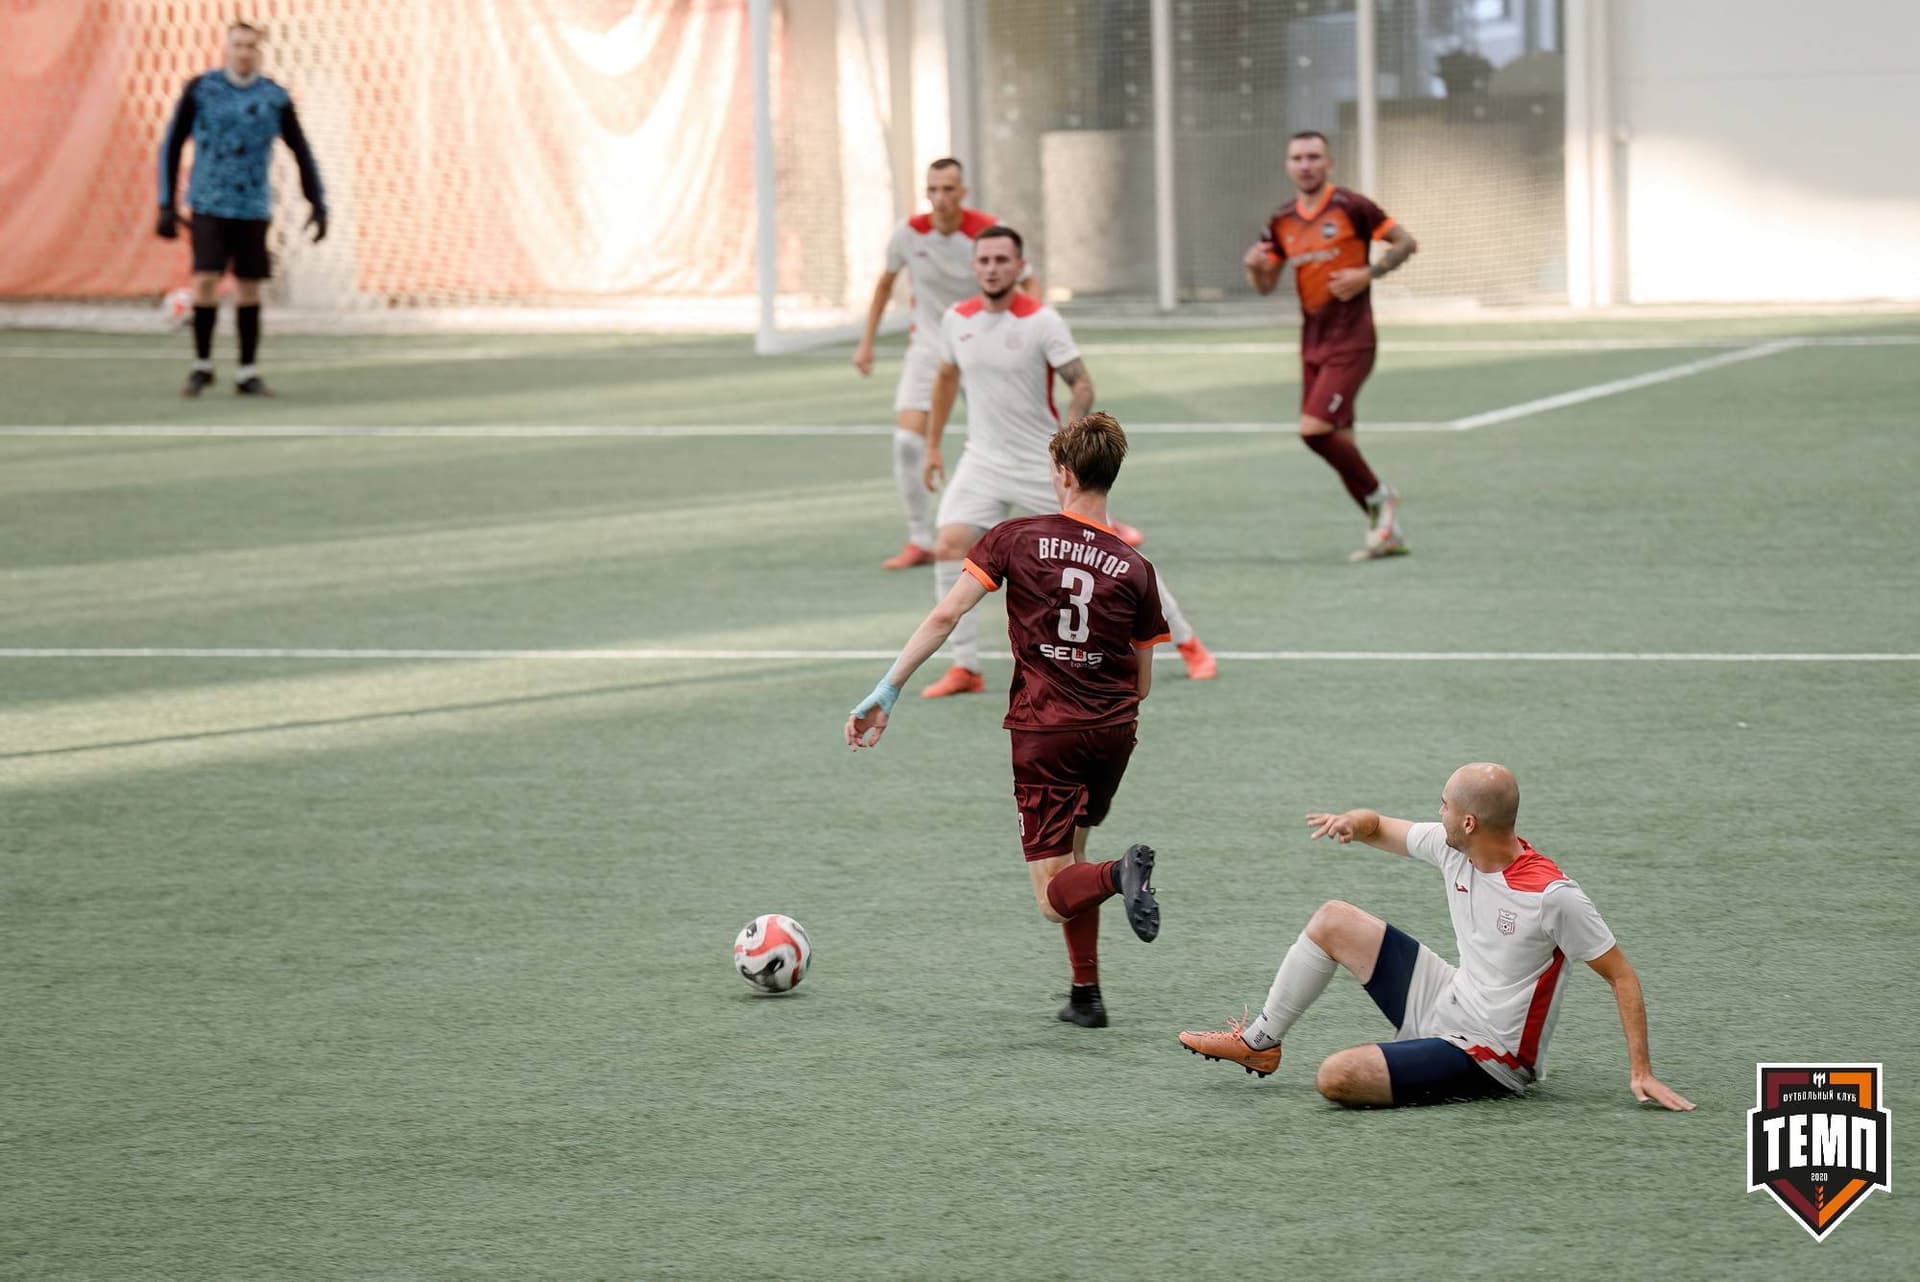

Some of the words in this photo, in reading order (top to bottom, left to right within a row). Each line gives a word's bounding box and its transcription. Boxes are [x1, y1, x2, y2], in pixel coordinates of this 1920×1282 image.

[1039, 537, 1130, 578] ВЕРНИГОР
[1057, 567, 1095, 643] 3
[1039, 643, 1103, 665] SEUS
